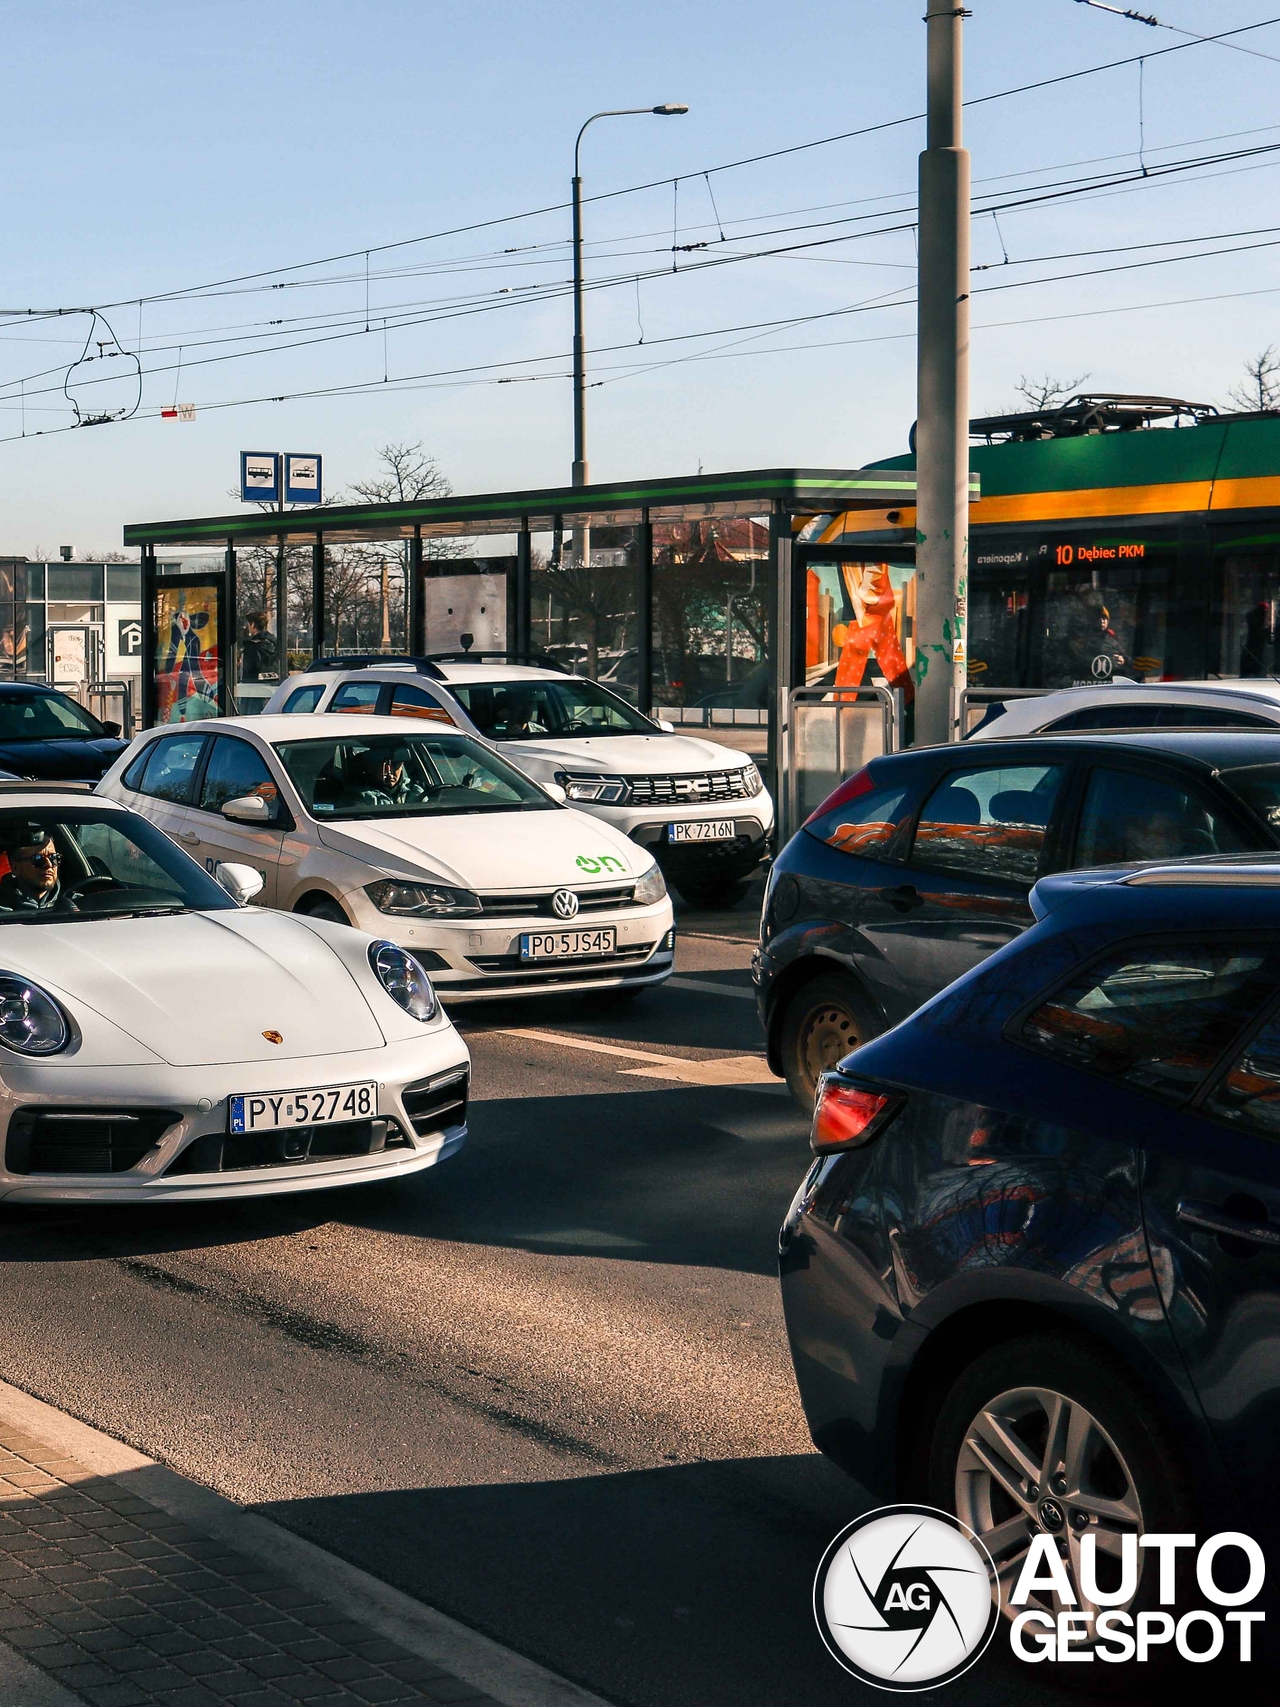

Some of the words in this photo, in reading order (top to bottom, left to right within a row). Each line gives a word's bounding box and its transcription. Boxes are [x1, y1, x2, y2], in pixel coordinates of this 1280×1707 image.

[180, 405, 194, 419] W
[1056, 545, 1073, 565] 10
[1078, 547, 1116, 562] Dębiec
[1118, 544, 1144, 558] PKM
[128, 631, 142, 653] P
[676, 825, 692, 839] PK
[696, 822, 733, 838] 7216N
[532, 935, 555, 955] PO
[561, 931, 611, 953] 5JS45
[233, 1119, 243, 1127] PL
[250, 1096, 284, 1128] PY
[295, 1087, 371, 1123] 52748
